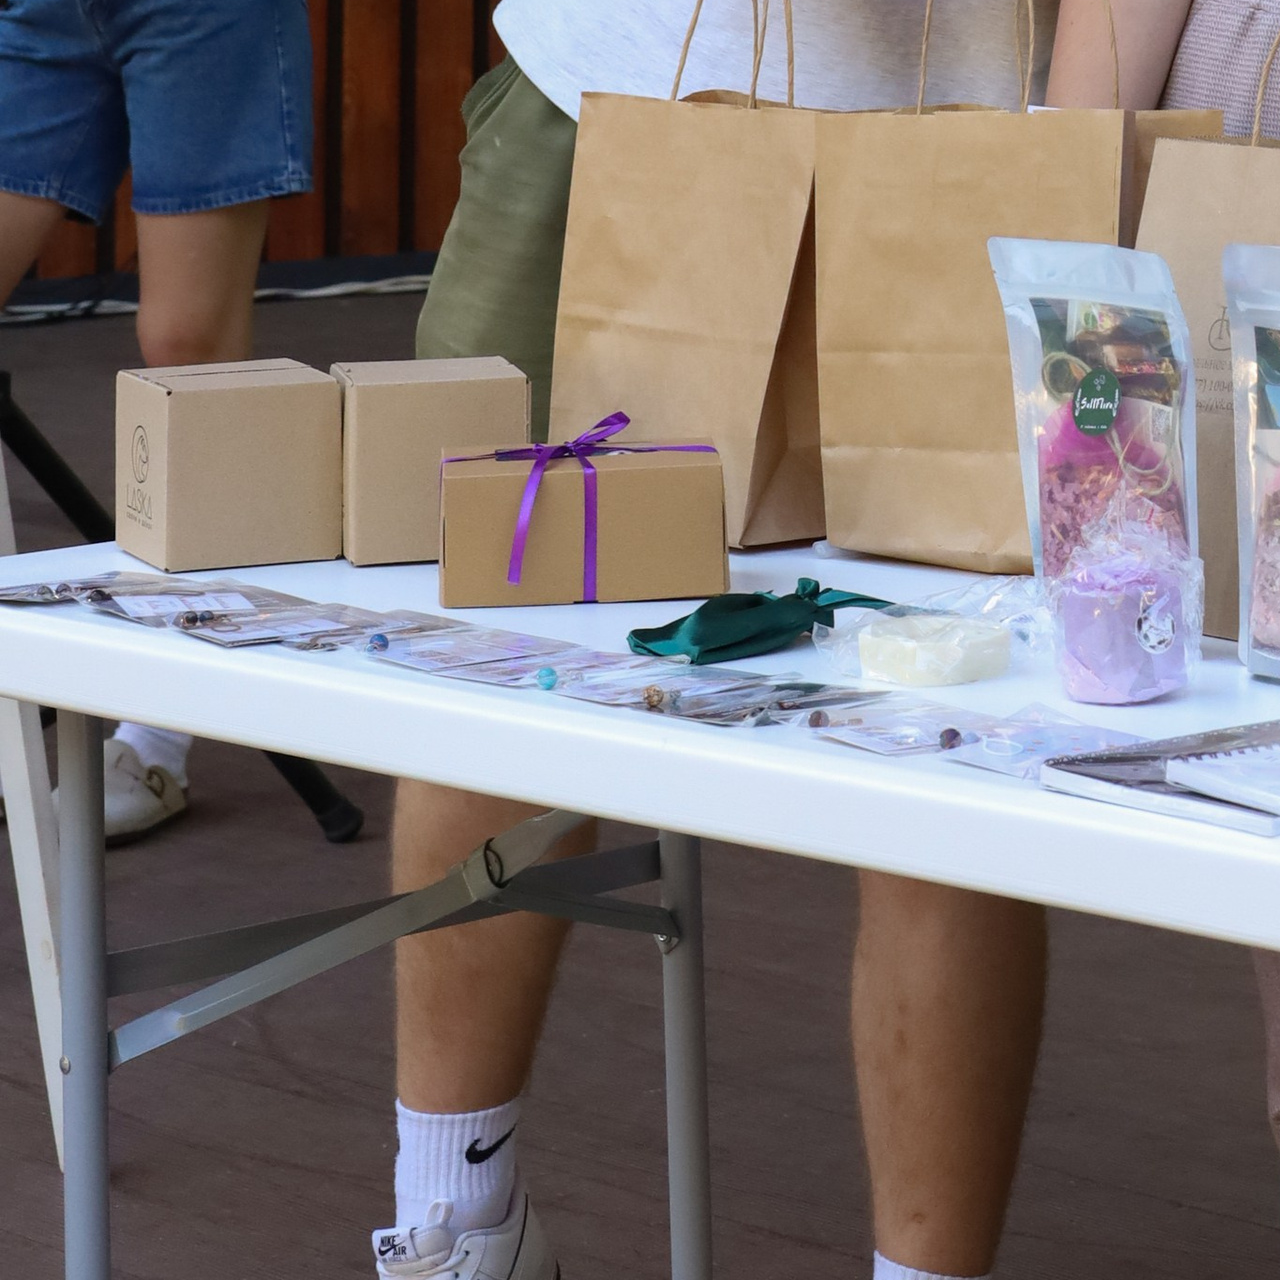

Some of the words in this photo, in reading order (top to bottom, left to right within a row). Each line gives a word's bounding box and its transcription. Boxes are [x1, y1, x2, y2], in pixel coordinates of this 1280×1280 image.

[126, 483, 153, 520] LASKA
[380, 1235, 397, 1247] NIKE
[393, 1246, 407, 1256] AIR
